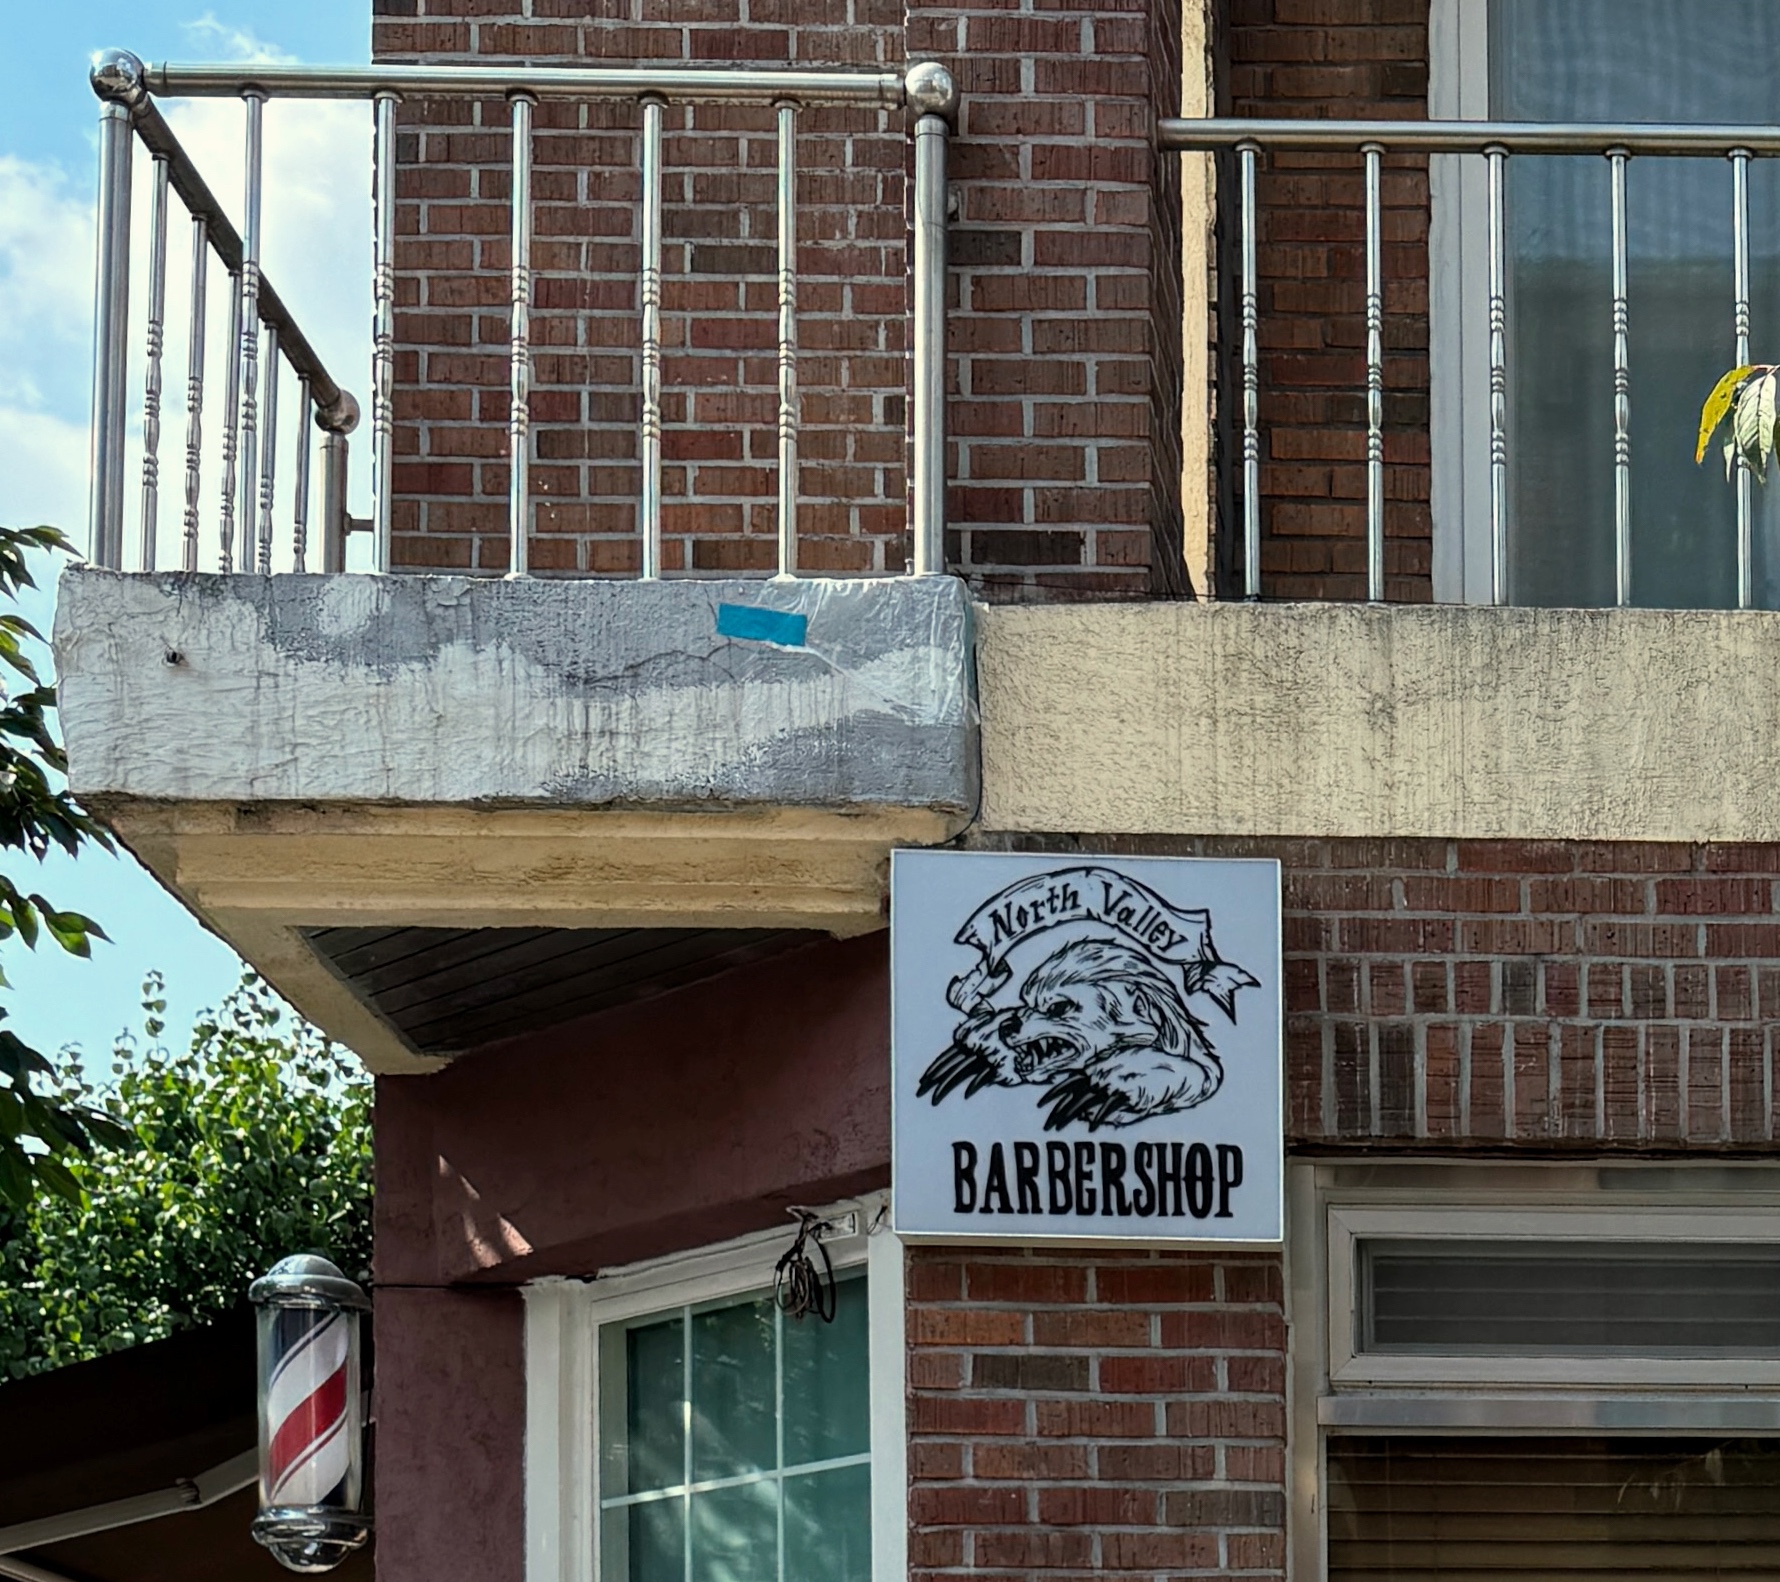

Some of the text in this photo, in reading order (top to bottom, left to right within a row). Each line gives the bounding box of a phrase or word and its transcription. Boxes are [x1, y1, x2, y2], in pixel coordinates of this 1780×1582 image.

[988, 881, 1191, 955] North Valley
[952, 1141, 1244, 1219] BARBERSHOP
